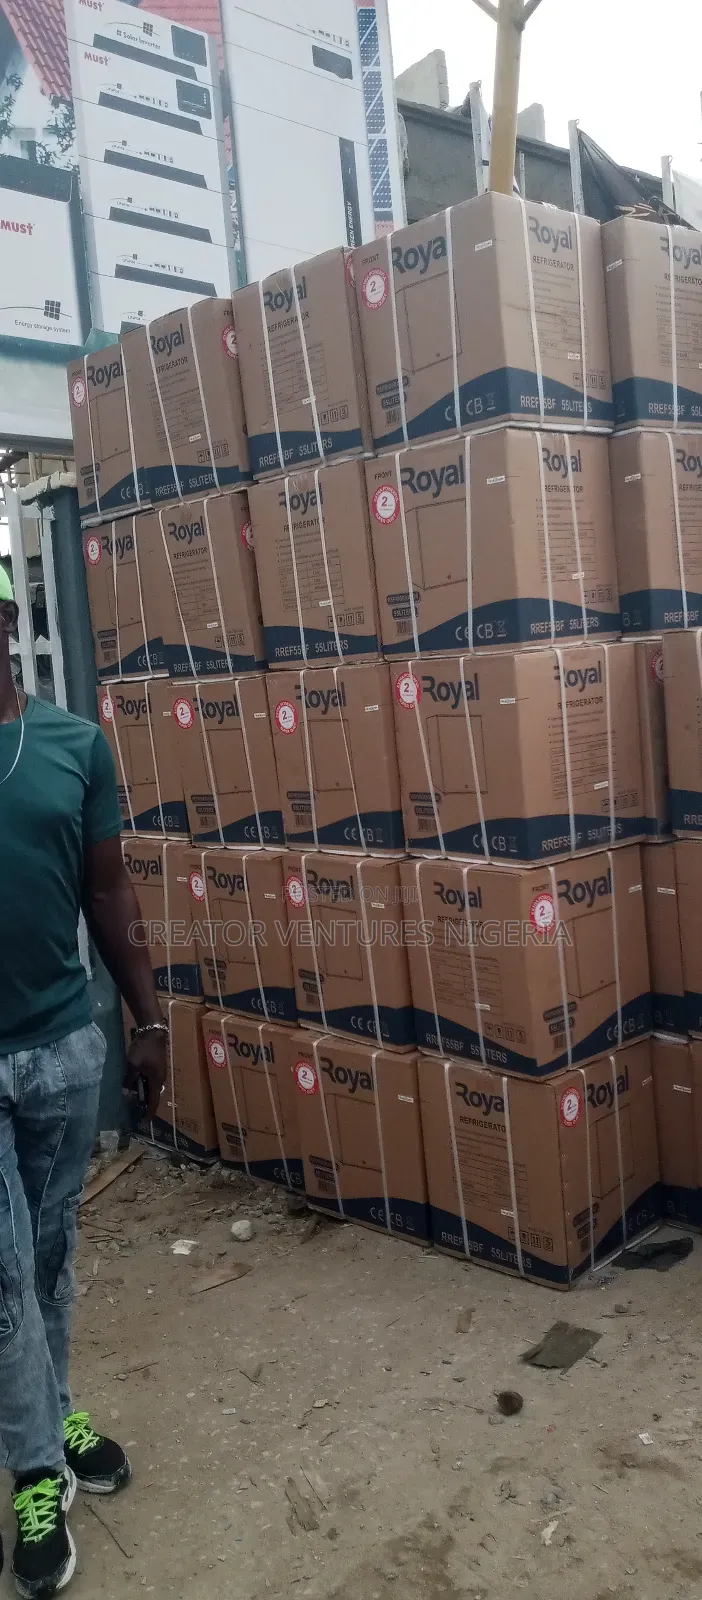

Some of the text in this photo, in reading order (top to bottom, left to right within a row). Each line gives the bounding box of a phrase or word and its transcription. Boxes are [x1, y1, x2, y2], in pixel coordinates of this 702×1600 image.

[528, 215, 573, 253] Royal
[362, 254, 379, 266] FRONT
[391, 235, 448, 274] Roya
[532, 255, 575, 271] REFRIGERATOR
[263, 276, 307, 314] Royal
[15, 319, 33, 330] Energy
[150, 323, 184, 357] Royal
[87, 354, 124, 388] Royal
[155, 356, 189, 375] EFRIGERATOR
[520, 395, 592, 413] RREF5BF 55LITES
[298, 437, 333, 457] 55LITRS
[374, 470, 392, 481] FRONT
[400, 454, 465, 499] Royal
[542, 448, 582, 479] Royal
[676, 448, 702, 478] Roy
[155, 472, 217, 497] RREF55F 55LITER
[544, 484, 584, 494] REFRIGERTOR
[168, 515, 205, 546] Royal
[173, 546, 208, 560] REFRIGERATOR
[569, 616, 600, 630] 55LIERS
[664, 610, 700, 624] RREF5BF
[275, 643, 310, 658] RREF55F
[422, 672, 480, 710] Royal
[557, 695, 604, 711] RFRIGERATOR
[116, 693, 152, 721] Royal
[193, 693, 240, 725] Royal
[541, 832, 582, 852] RREF55F
[124, 854, 162, 880] Royal
[206, 866, 247, 897] Roya
[307, 869, 355, 905] Royal
[434, 881, 482, 913] Royal
[557, 868, 613, 909] Royal
[227, 1033, 275, 1066] Royal
[426, 1032, 507, 1064] RRF55BF 55TERS
[455, 1082, 505, 1117] Roya
[585, 1064, 629, 1109] Royal
[459, 1115, 507, 1133] REFRIGERATO
[441, 1230, 484, 1253] RREF5BF
